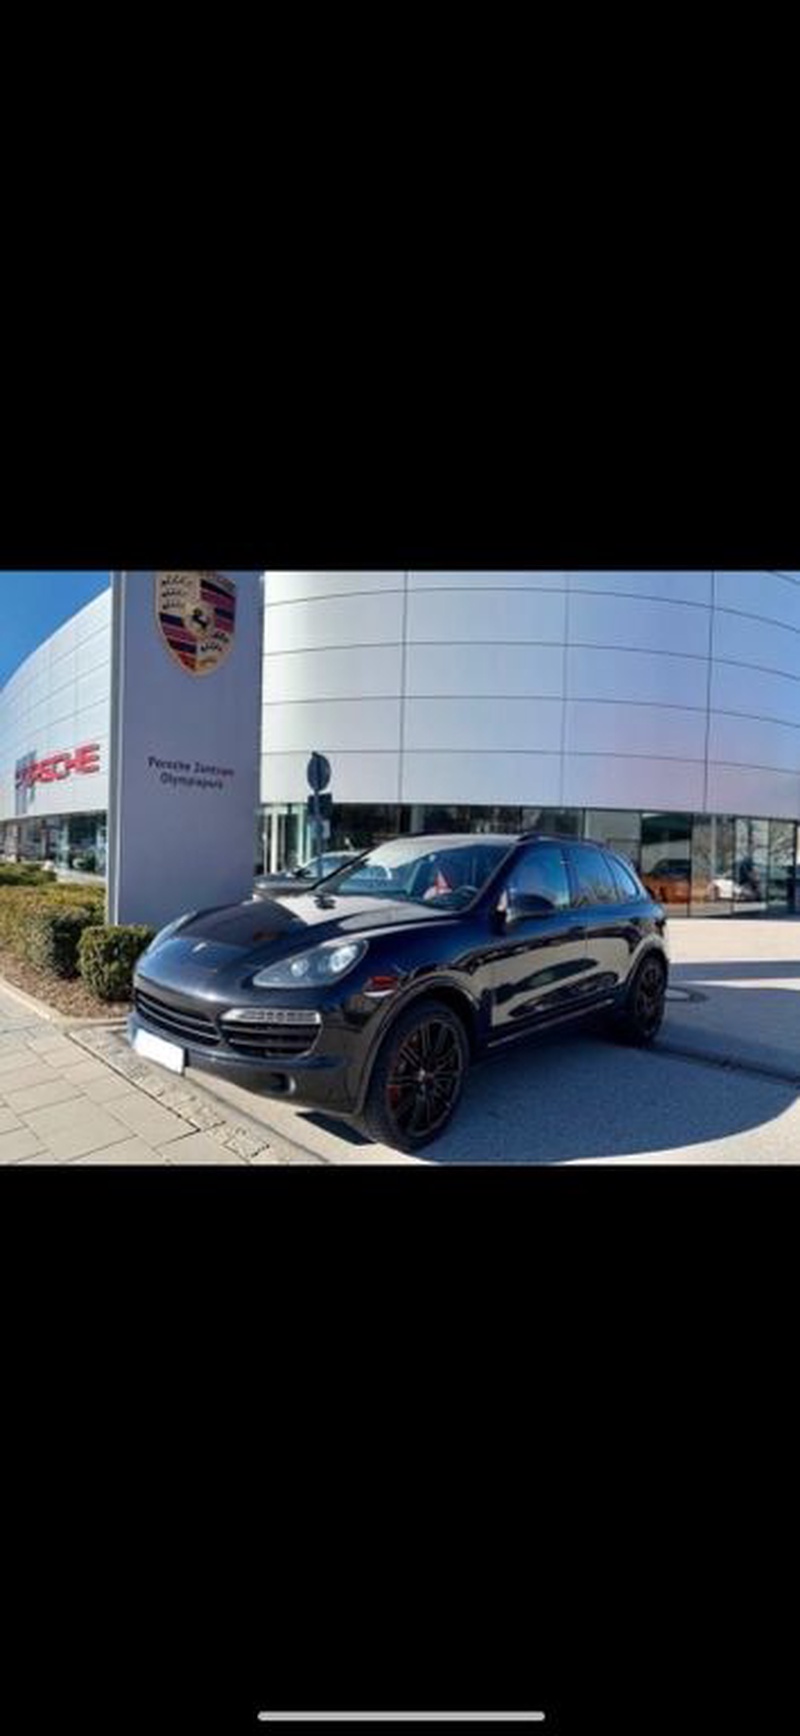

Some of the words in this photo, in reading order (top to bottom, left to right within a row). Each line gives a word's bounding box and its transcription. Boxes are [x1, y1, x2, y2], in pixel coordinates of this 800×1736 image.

[15, 743, 100, 790] RSCHE
[148, 756, 191, 772] Porsche
[194, 761, 235, 777] Zentrum
